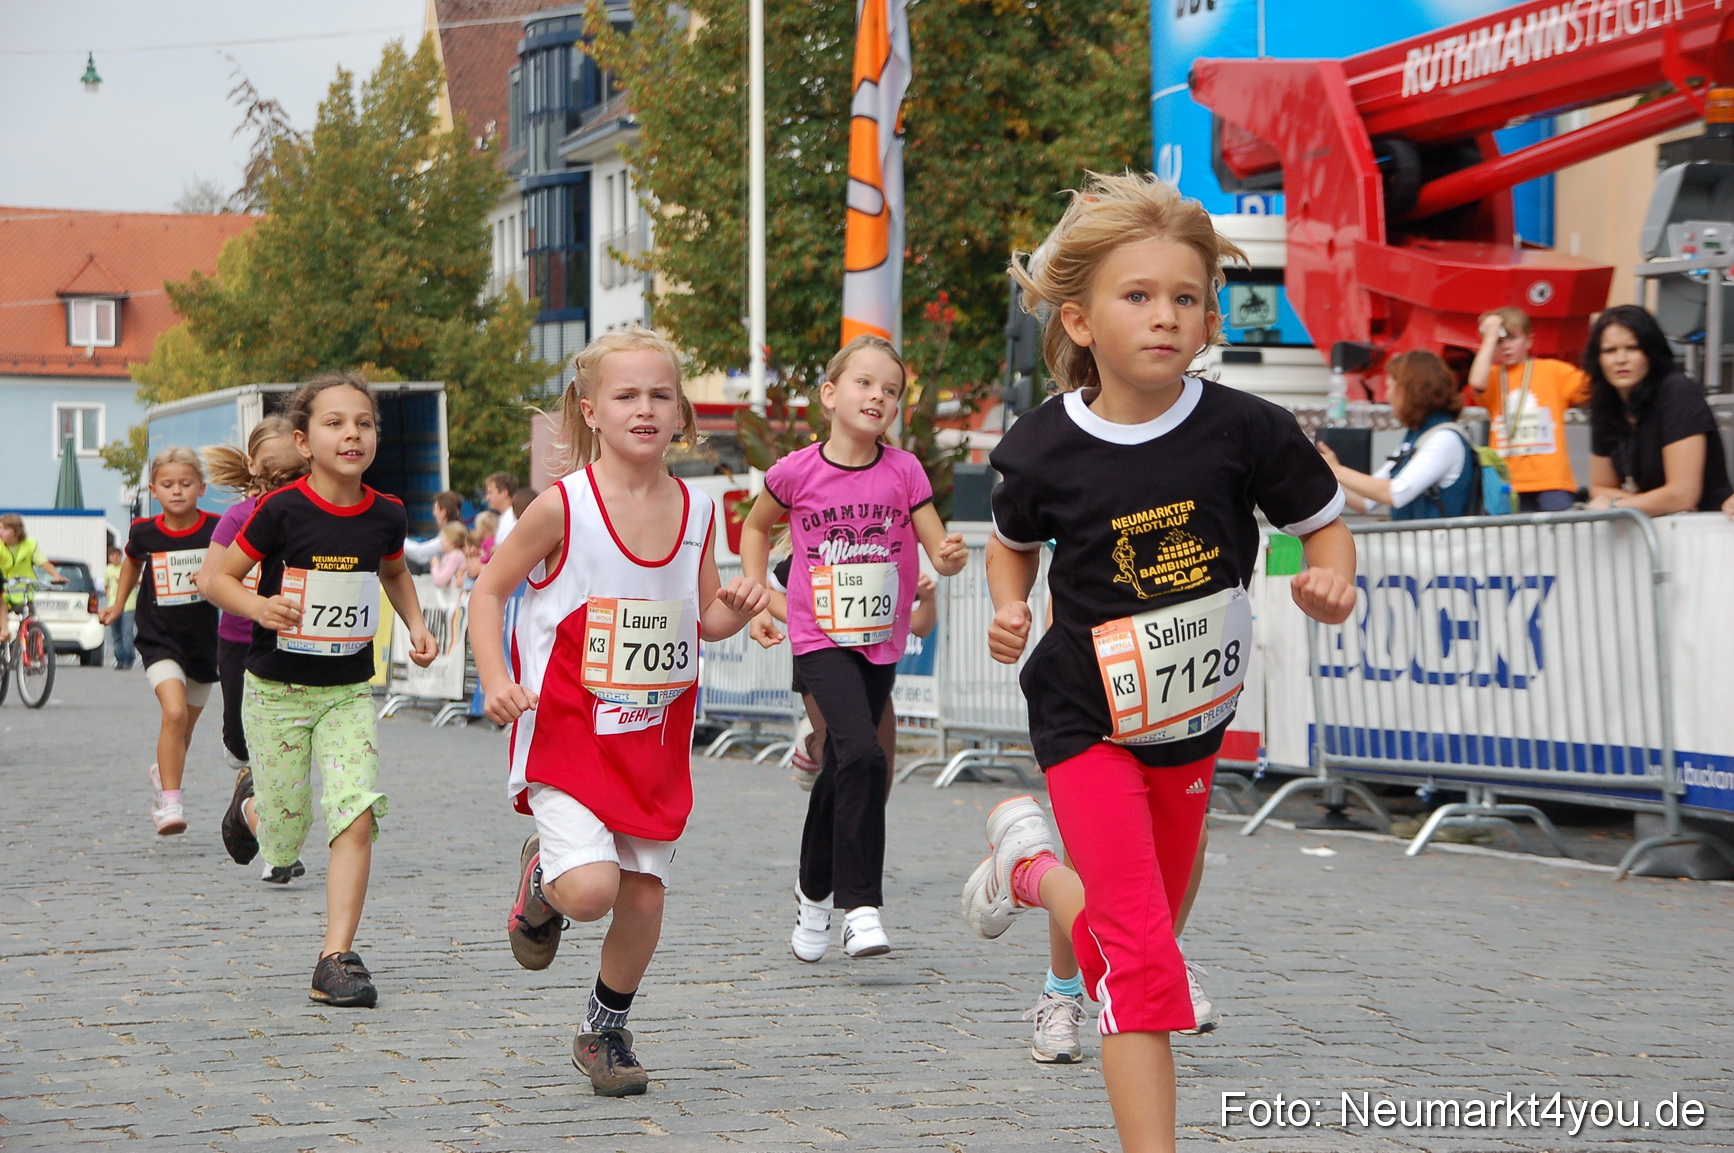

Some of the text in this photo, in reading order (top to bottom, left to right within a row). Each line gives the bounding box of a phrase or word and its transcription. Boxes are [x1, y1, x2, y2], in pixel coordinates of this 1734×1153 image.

[801, 503, 911, 532] COMMUNITY
[1111, 500, 1196, 531] NEUMARKTER
[1121, 513, 1190, 537] STADTLAUF
[170, 554, 203, 567] Daniela
[311, 555, 359, 565] NEUMARKTER
[818, 539, 890, 567] Winners
[1139, 546, 1221, 579] BAMBINILAUF
[315, 562, 354, 571] STADTLAUF
[837, 571, 864, 587] Lisa
[816, 596, 829, 609] K3
[841, 594, 892, 619] 7129
[311, 604, 370, 628] 7251
[622, 607, 668, 630] Laura
[588, 636, 606, 654] K3
[1144, 617, 1208, 650] Selina
[622, 640, 690, 673] 7033
[1155, 639, 1241, 704] 7128
[1112, 673, 1136, 697] K3
